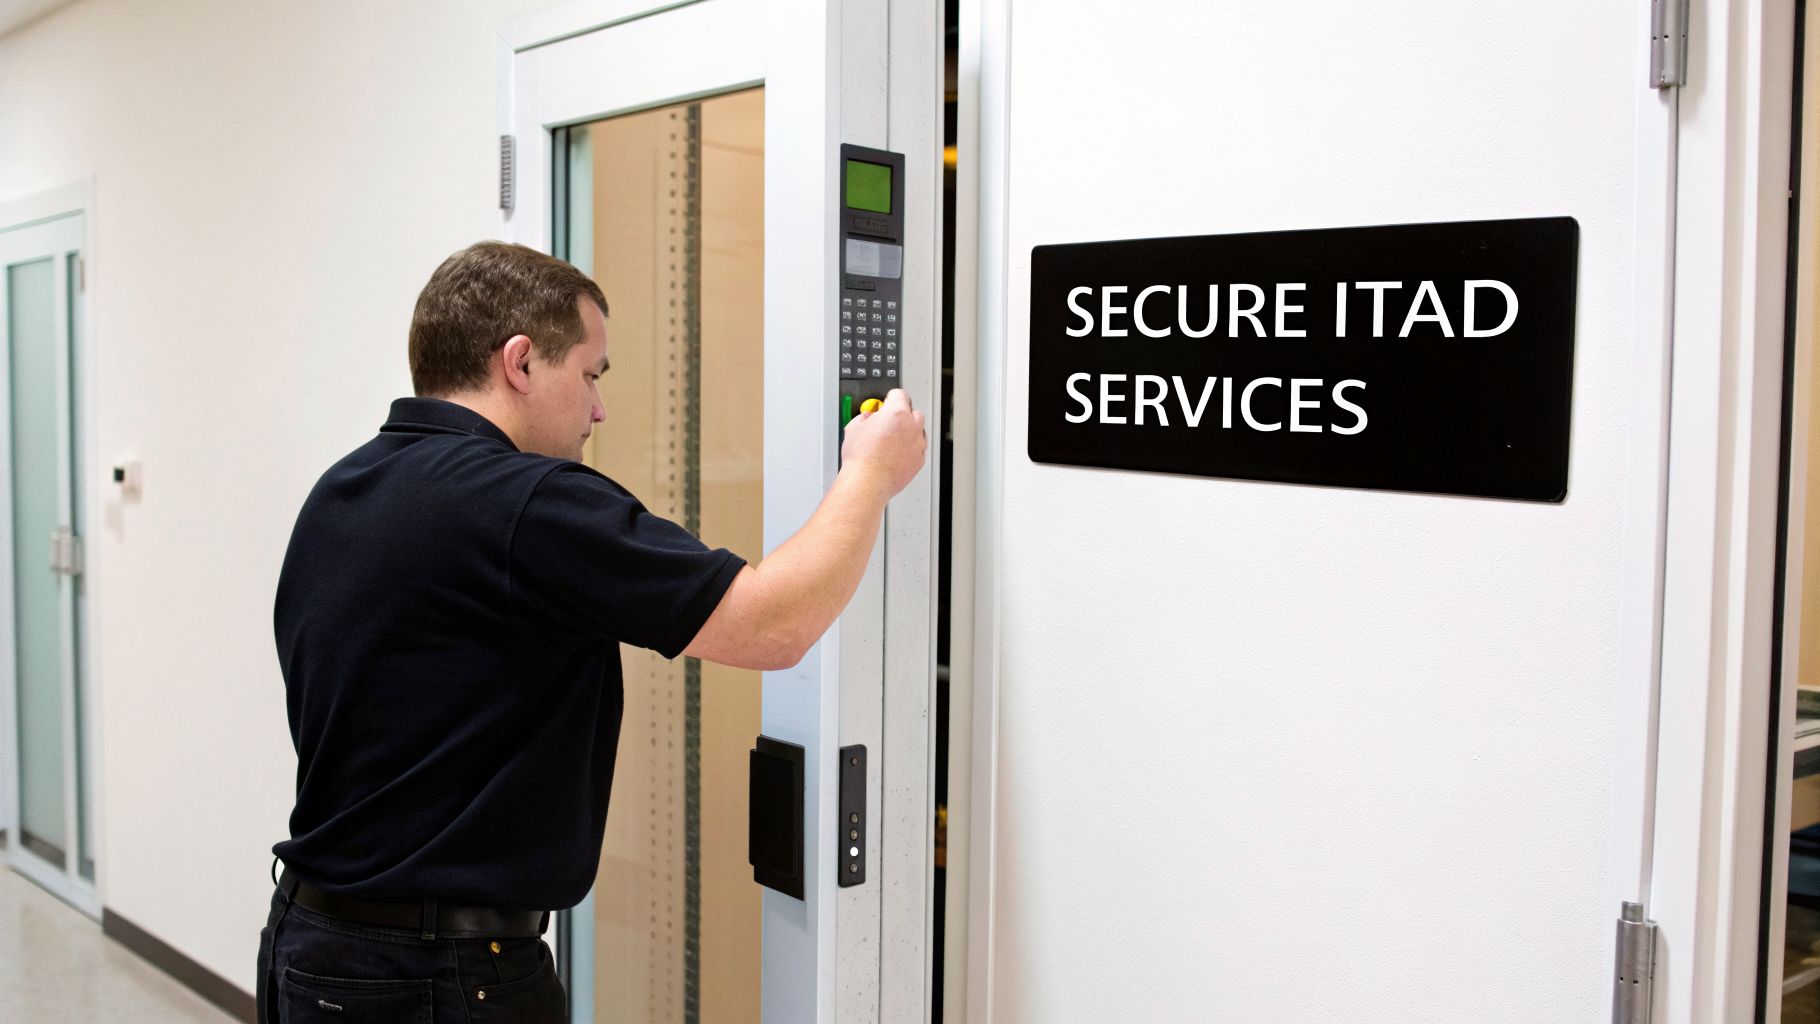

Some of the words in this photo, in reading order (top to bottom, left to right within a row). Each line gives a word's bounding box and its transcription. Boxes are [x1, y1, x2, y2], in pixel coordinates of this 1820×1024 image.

[1066, 283, 1306, 338] SECURE
[1336, 280, 1518, 337] ITAD
[1065, 373, 1368, 435] SERVICES
